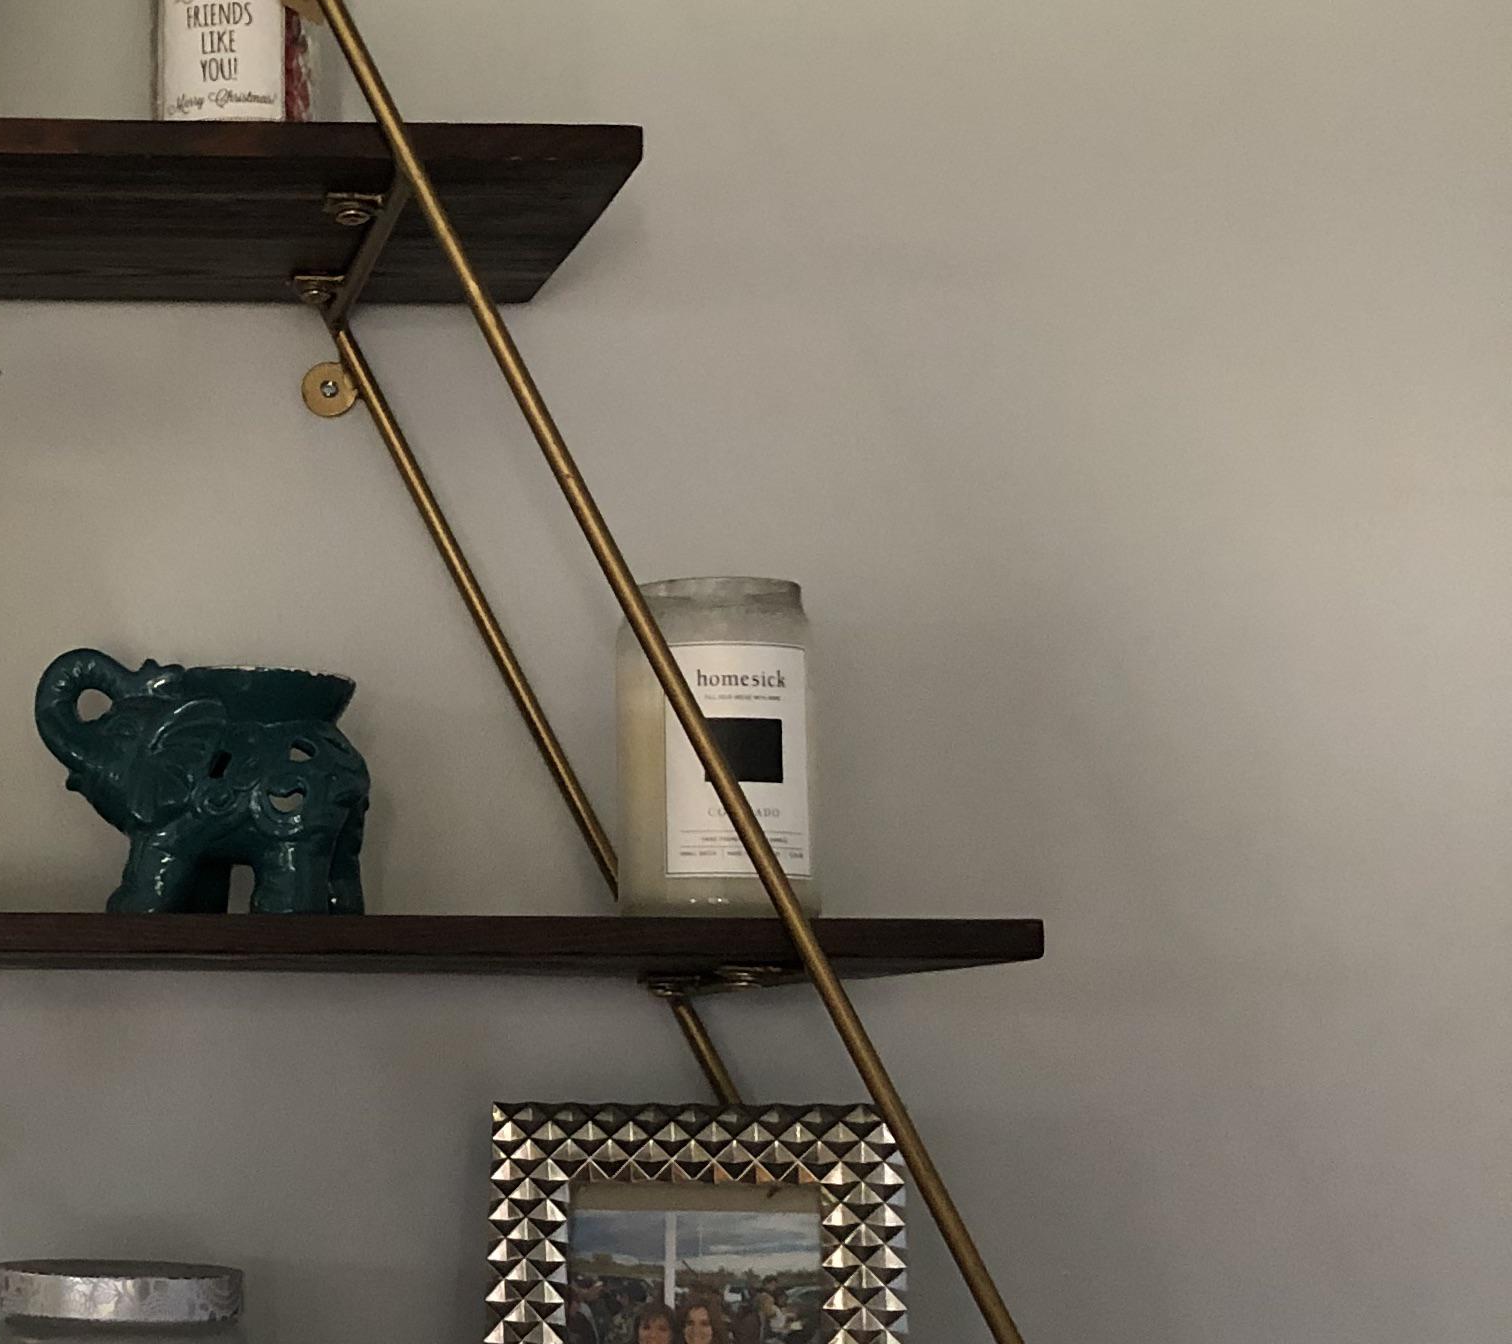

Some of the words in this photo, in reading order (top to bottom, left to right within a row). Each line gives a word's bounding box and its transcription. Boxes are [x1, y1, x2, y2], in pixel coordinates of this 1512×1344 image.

[186, 2, 253, 29] FRIENDS
[201, 29, 236, 55] LIKE
[199, 57, 239, 83] YOU!
[168, 93, 205, 116] Merry
[696, 668, 787, 689] homesick
[707, 807, 781, 819] COADO
